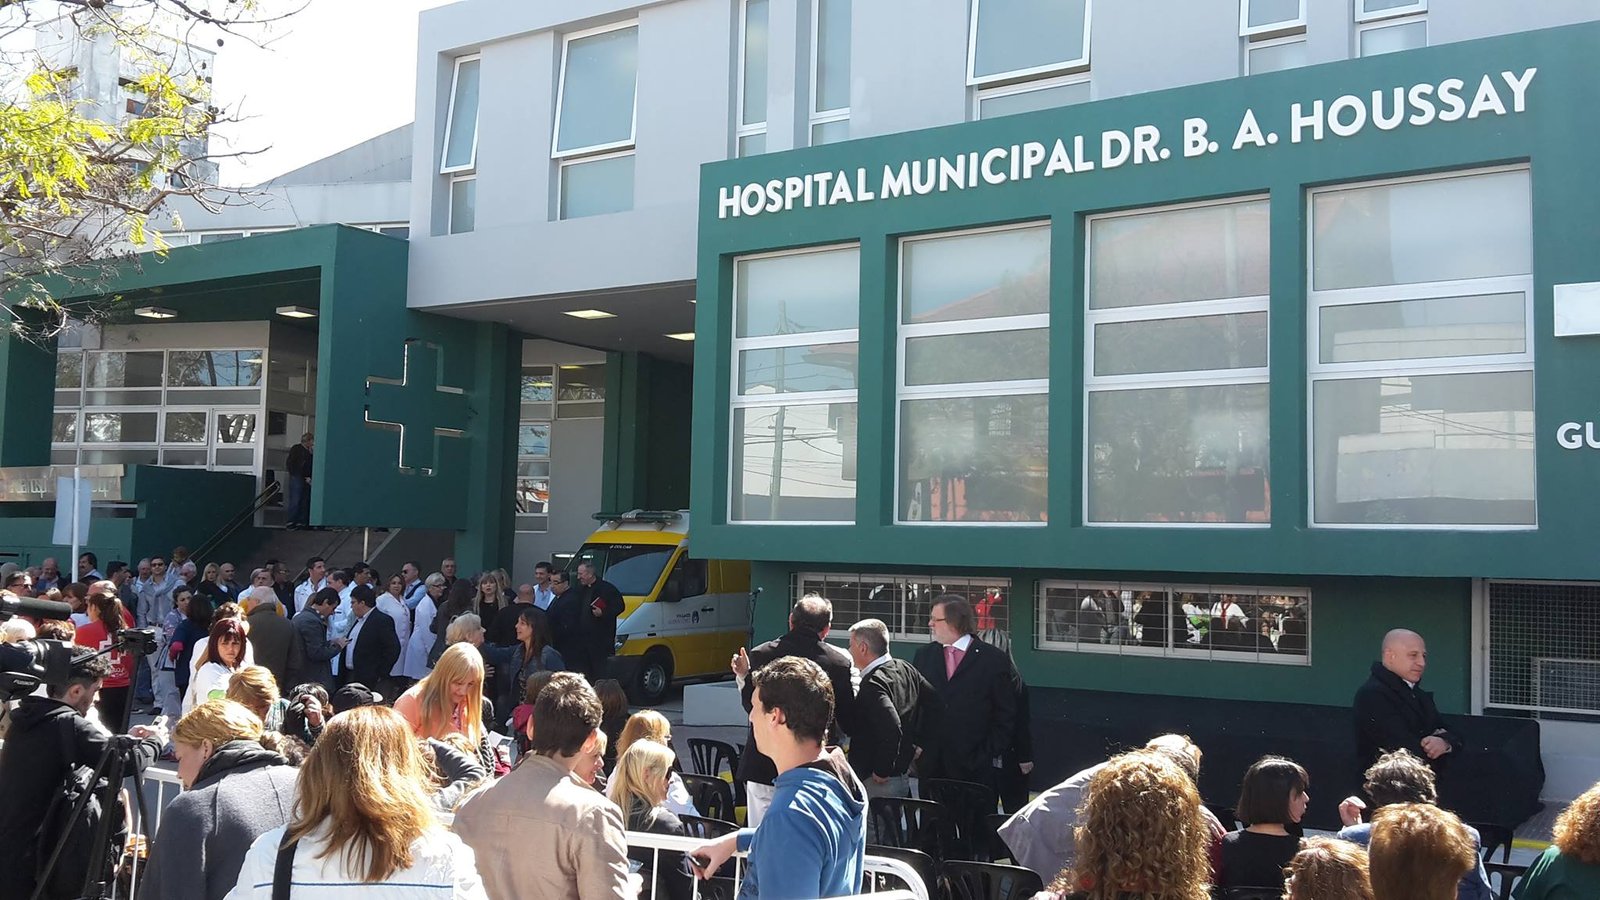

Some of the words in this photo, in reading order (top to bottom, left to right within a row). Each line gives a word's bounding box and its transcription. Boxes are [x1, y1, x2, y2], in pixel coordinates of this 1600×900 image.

[717, 167, 875, 219] HOSPITAL
[879, 134, 1096, 200] MUNICIPAL
[1100, 125, 1171, 170] DR.
[1183, 117, 1220, 158] B.
[1231, 108, 1279, 150] A.
[1290, 66, 1538, 143] HOUSSAY
